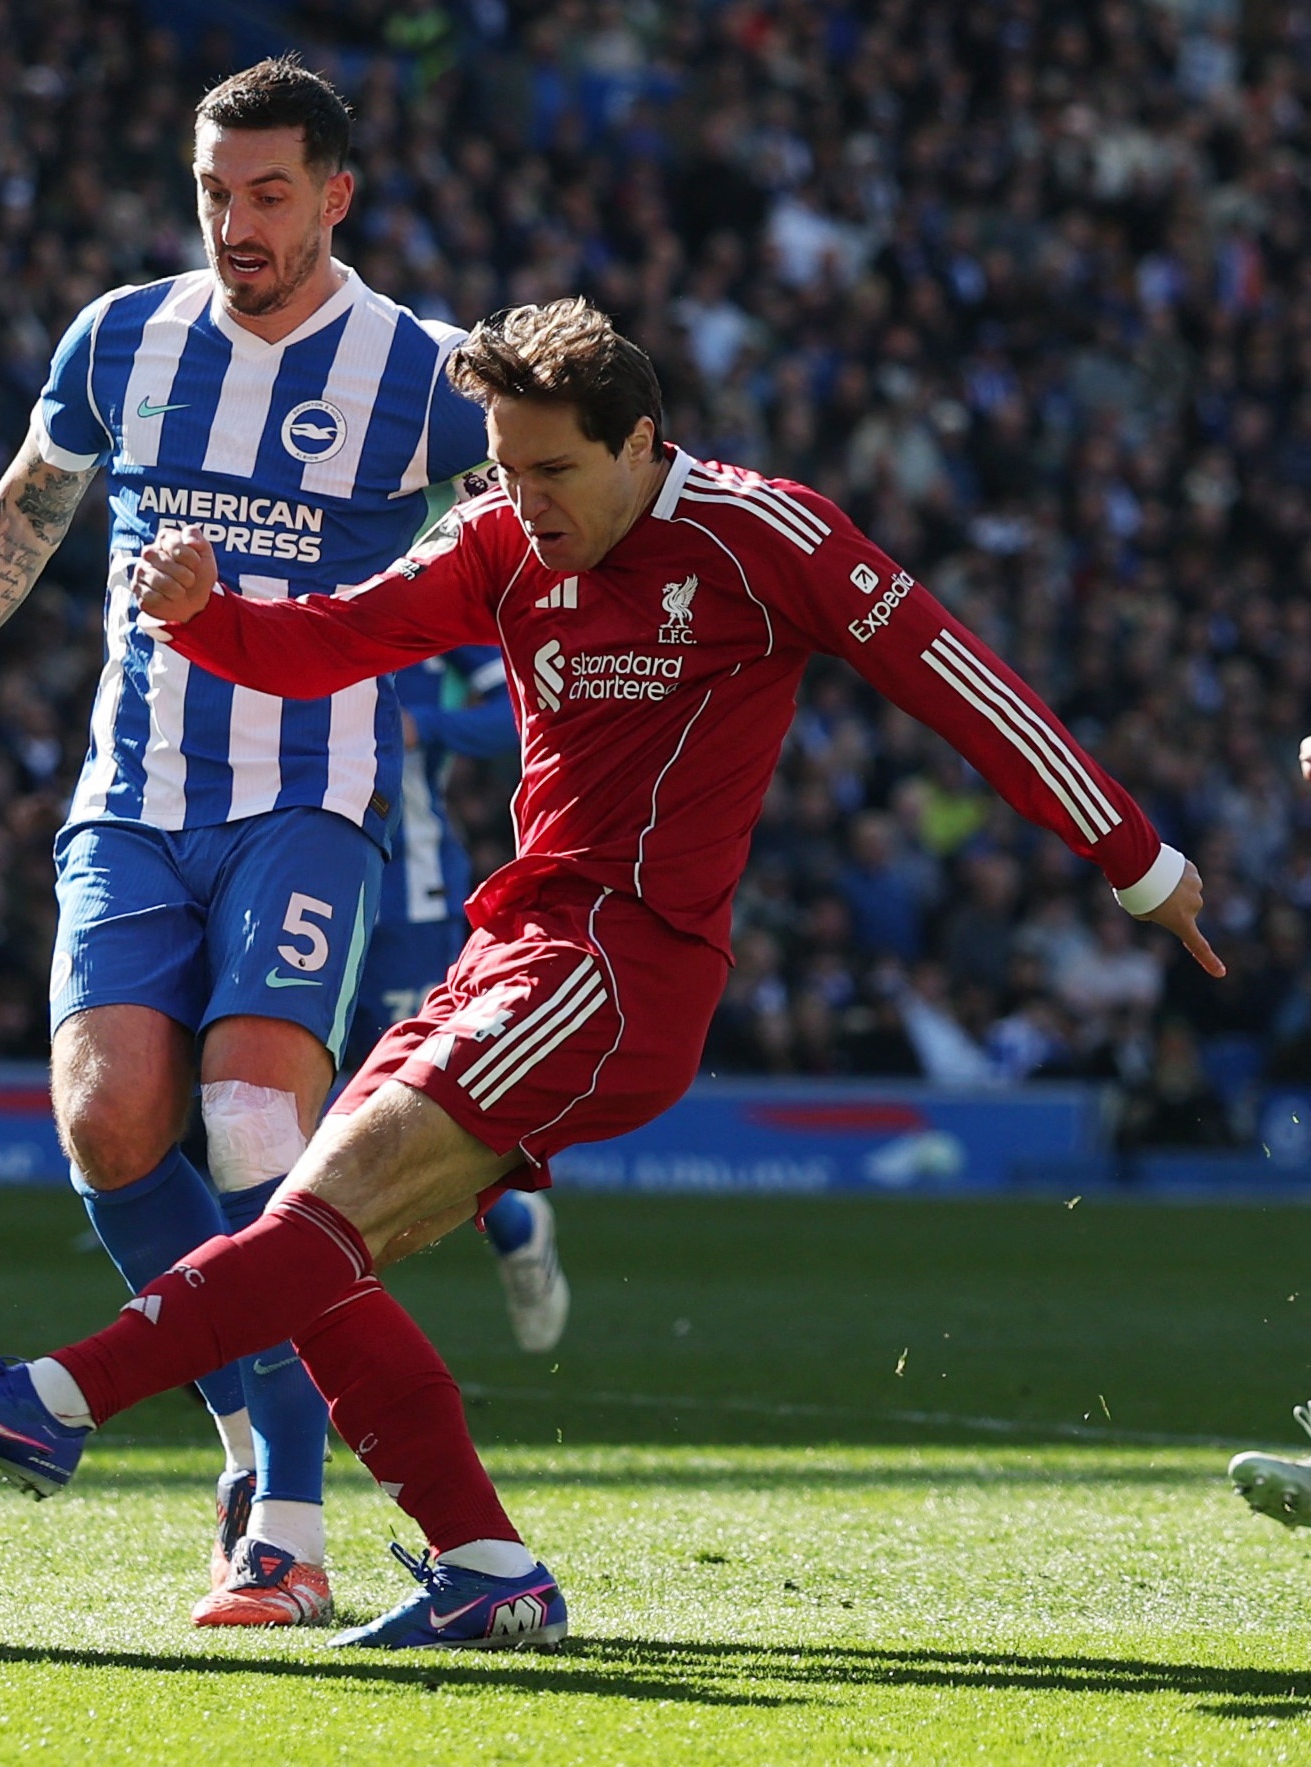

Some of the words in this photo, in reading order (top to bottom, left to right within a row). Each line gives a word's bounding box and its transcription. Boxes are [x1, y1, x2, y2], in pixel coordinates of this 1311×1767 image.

[139, 486, 323, 532] AMERICAN
[848, 570, 915, 643] Expedia
[570, 650, 682, 678] standard
[277, 891, 333, 972] 5
